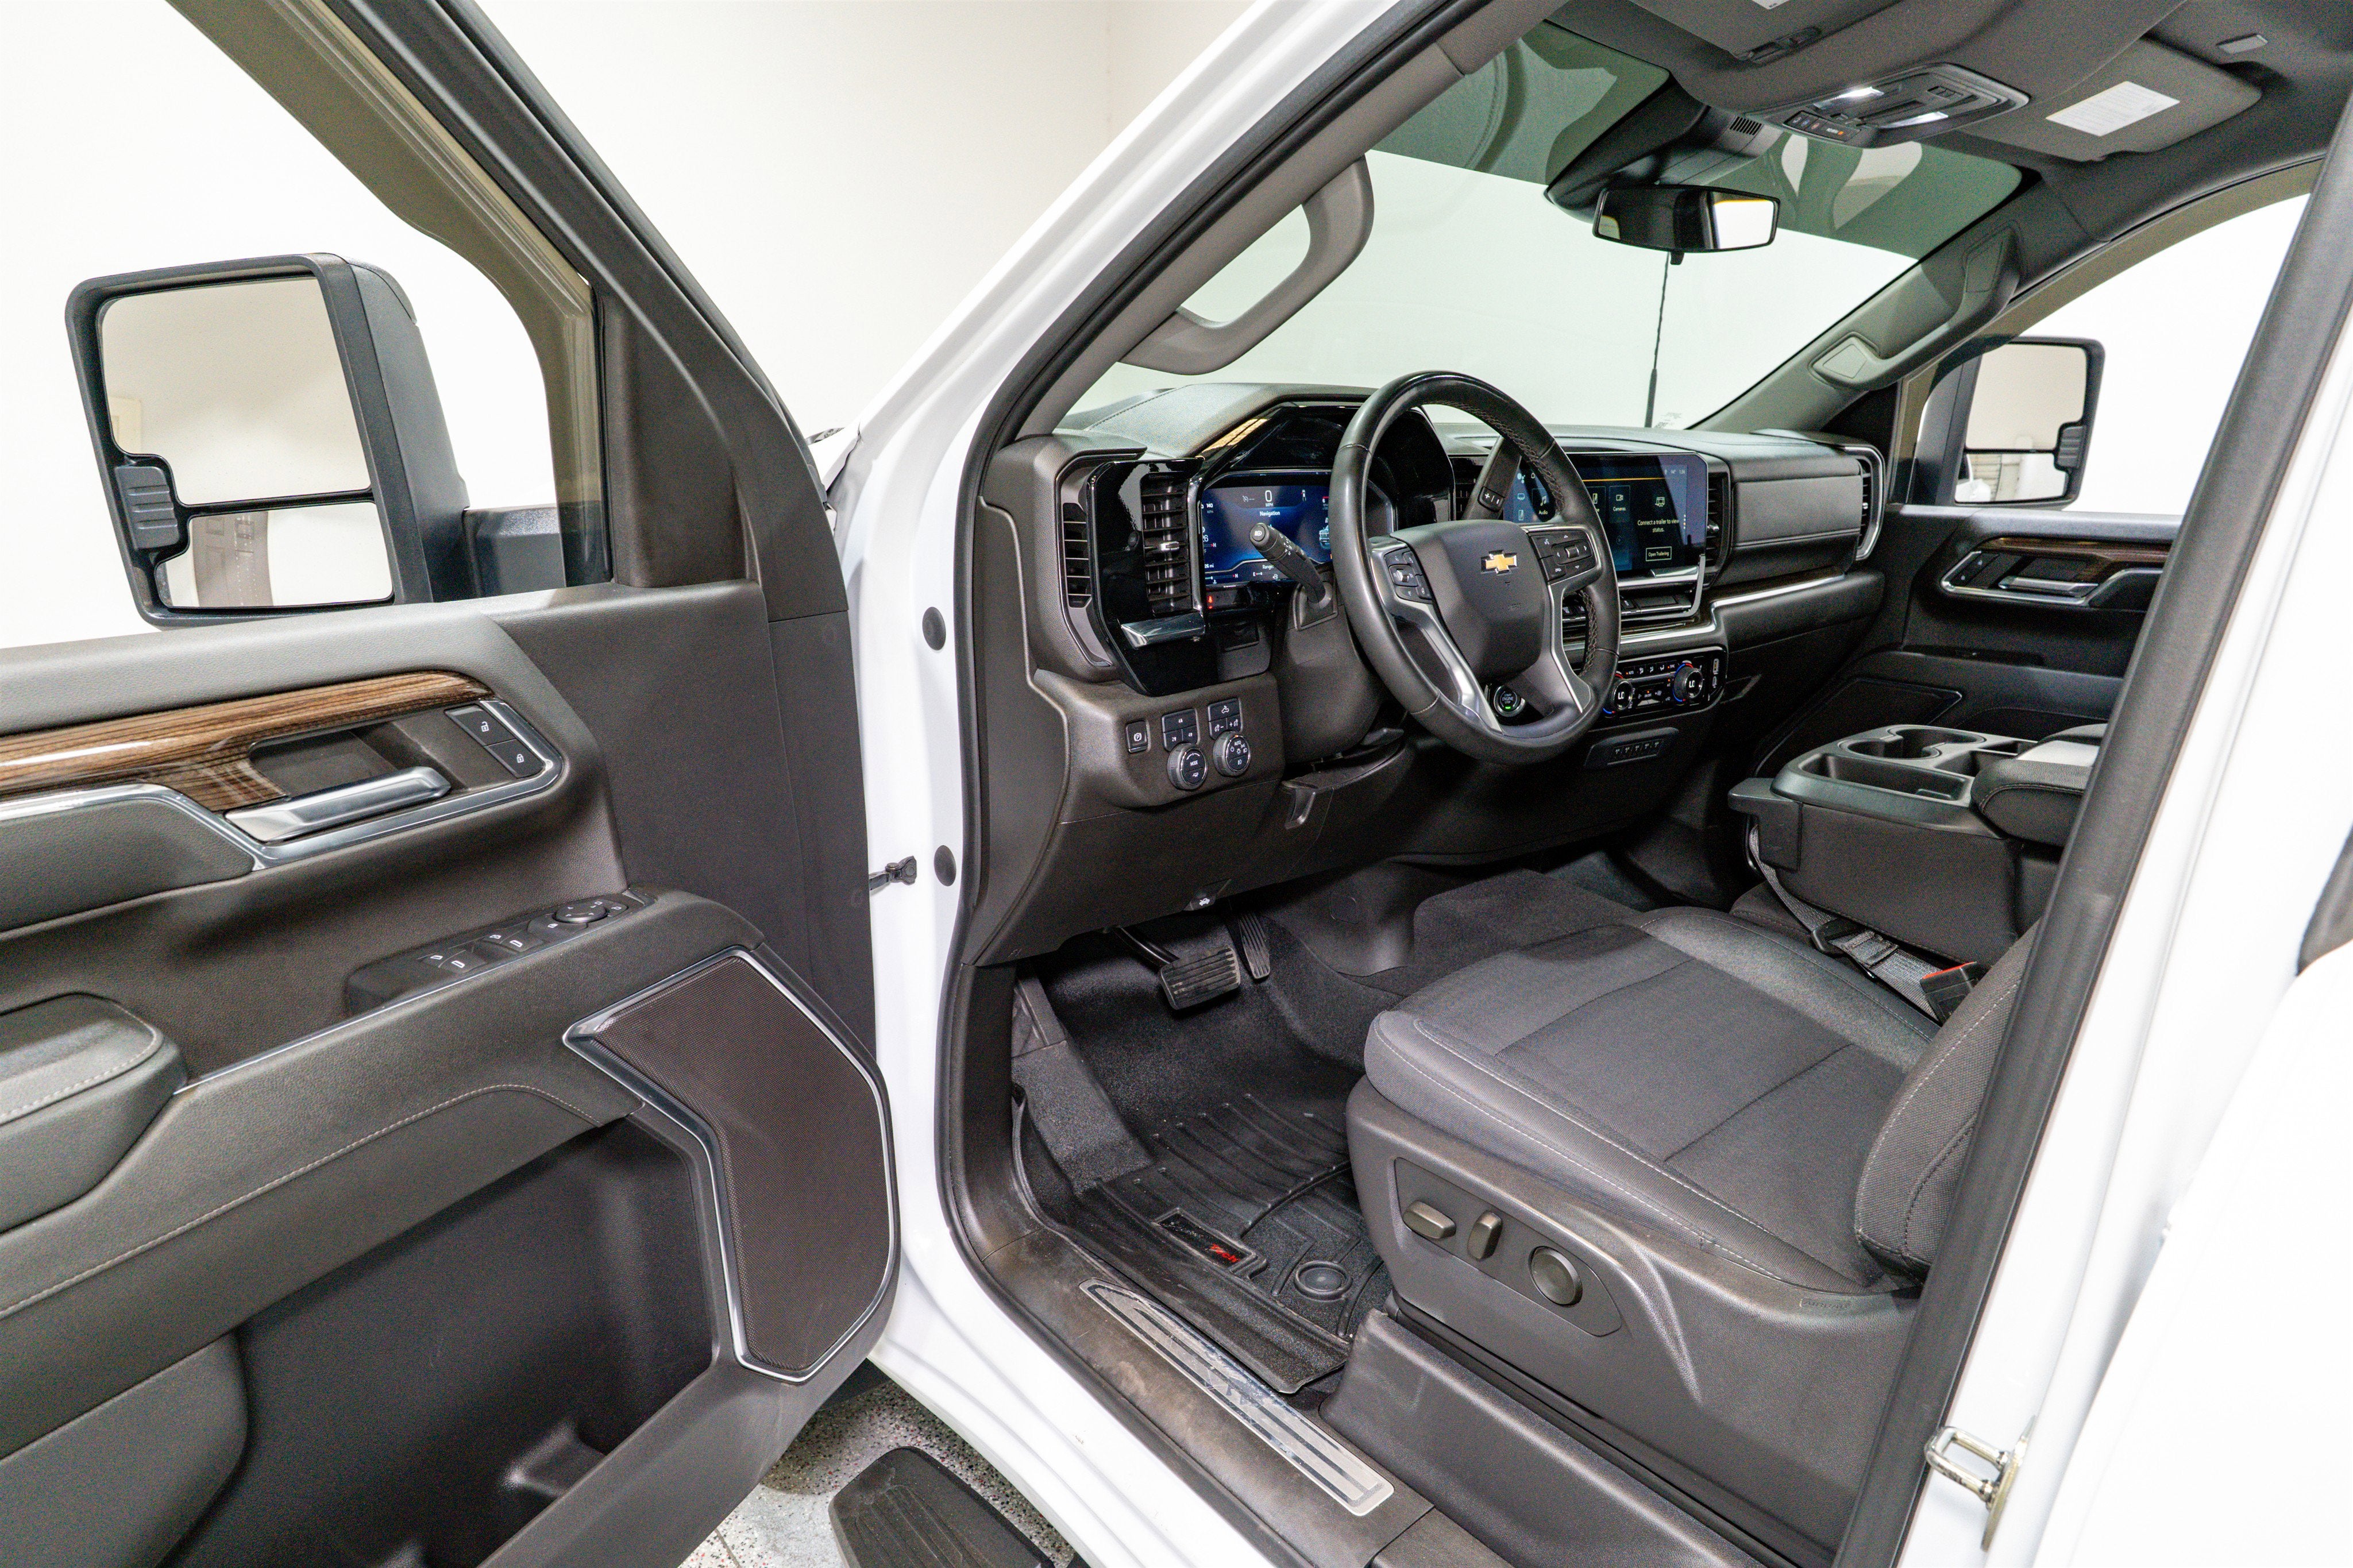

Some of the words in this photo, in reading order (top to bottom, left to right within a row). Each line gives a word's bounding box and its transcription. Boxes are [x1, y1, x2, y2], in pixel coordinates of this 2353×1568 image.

[1264, 490, 1272, 502] 0
[1688, 680, 1695, 688] LO
[1618, 692, 1625, 700] LO
